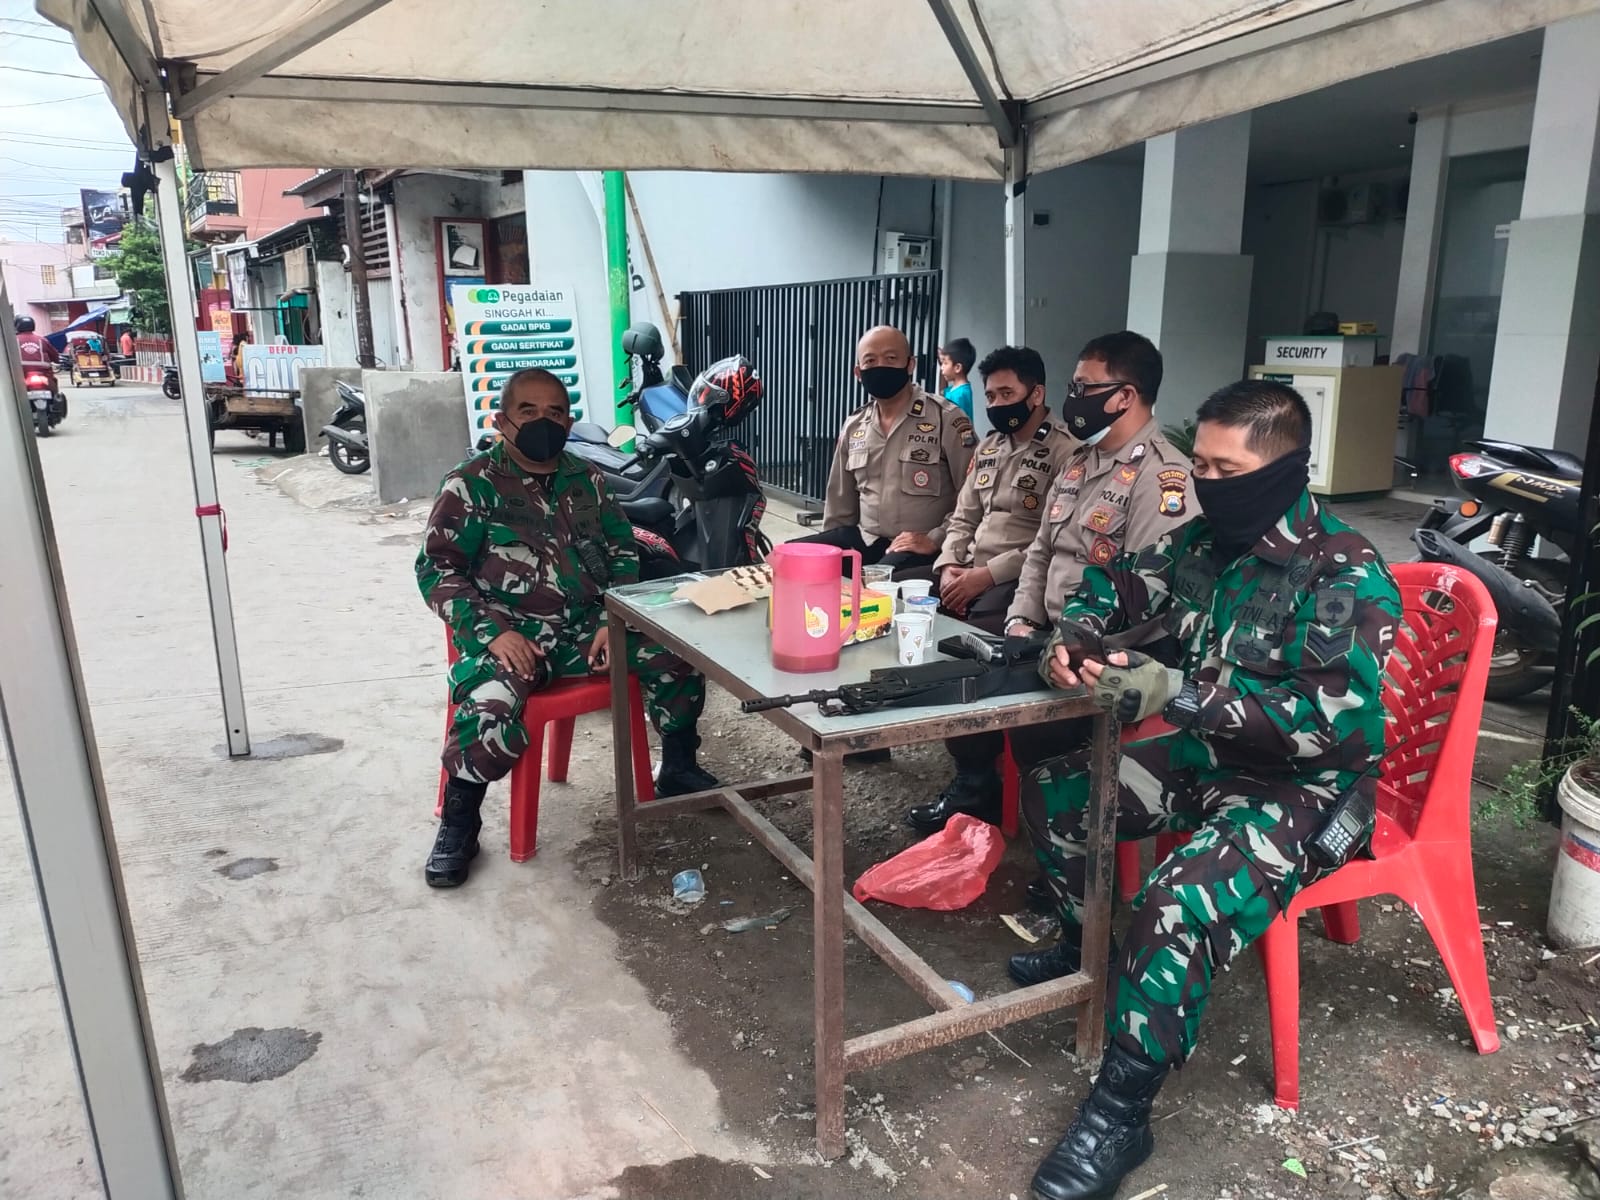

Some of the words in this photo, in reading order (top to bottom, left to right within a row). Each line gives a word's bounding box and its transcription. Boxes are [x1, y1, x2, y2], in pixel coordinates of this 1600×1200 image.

[502, 290, 563, 304] Pegadaian
[484, 308, 533, 318] SINGGAH
[501, 323, 527, 331] GADAI
[529, 322, 551, 331] BPKB
[269, 346, 298, 355] DEPOT
[491, 342, 518, 351] GADAI
[519, 341, 564, 350] SERTIFIKAT
[1276, 346, 1328, 359] SECURITY
[495, 360, 514, 369] BELI
[515, 359, 566, 368] KENDARAAN
[908, 434, 938, 445] POLRI
[1020, 458, 1051, 473] POLRI
[1515, 476, 1567, 494] NMAX
